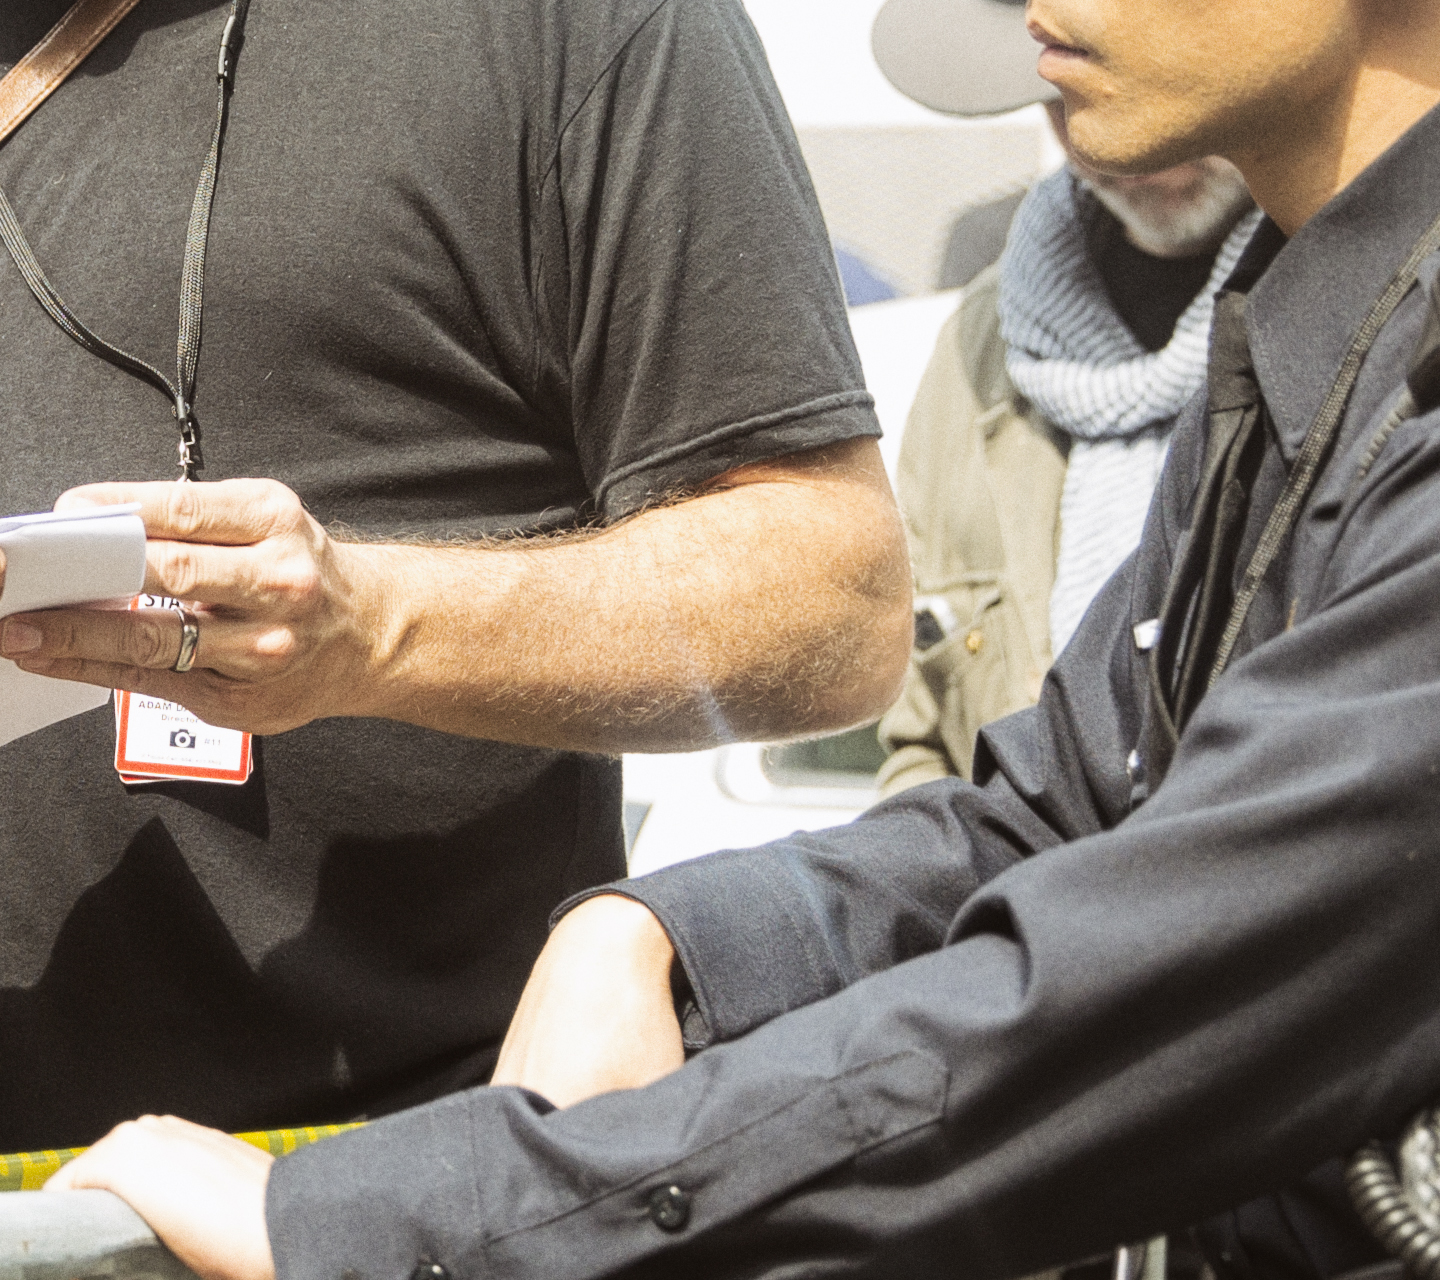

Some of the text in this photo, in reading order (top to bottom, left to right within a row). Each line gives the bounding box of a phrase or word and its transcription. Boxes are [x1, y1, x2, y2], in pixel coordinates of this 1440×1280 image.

[139, 701, 172, 711] ADAM
[162, 714, 198, 723] Director
[204, 738, 221, 746] #11
